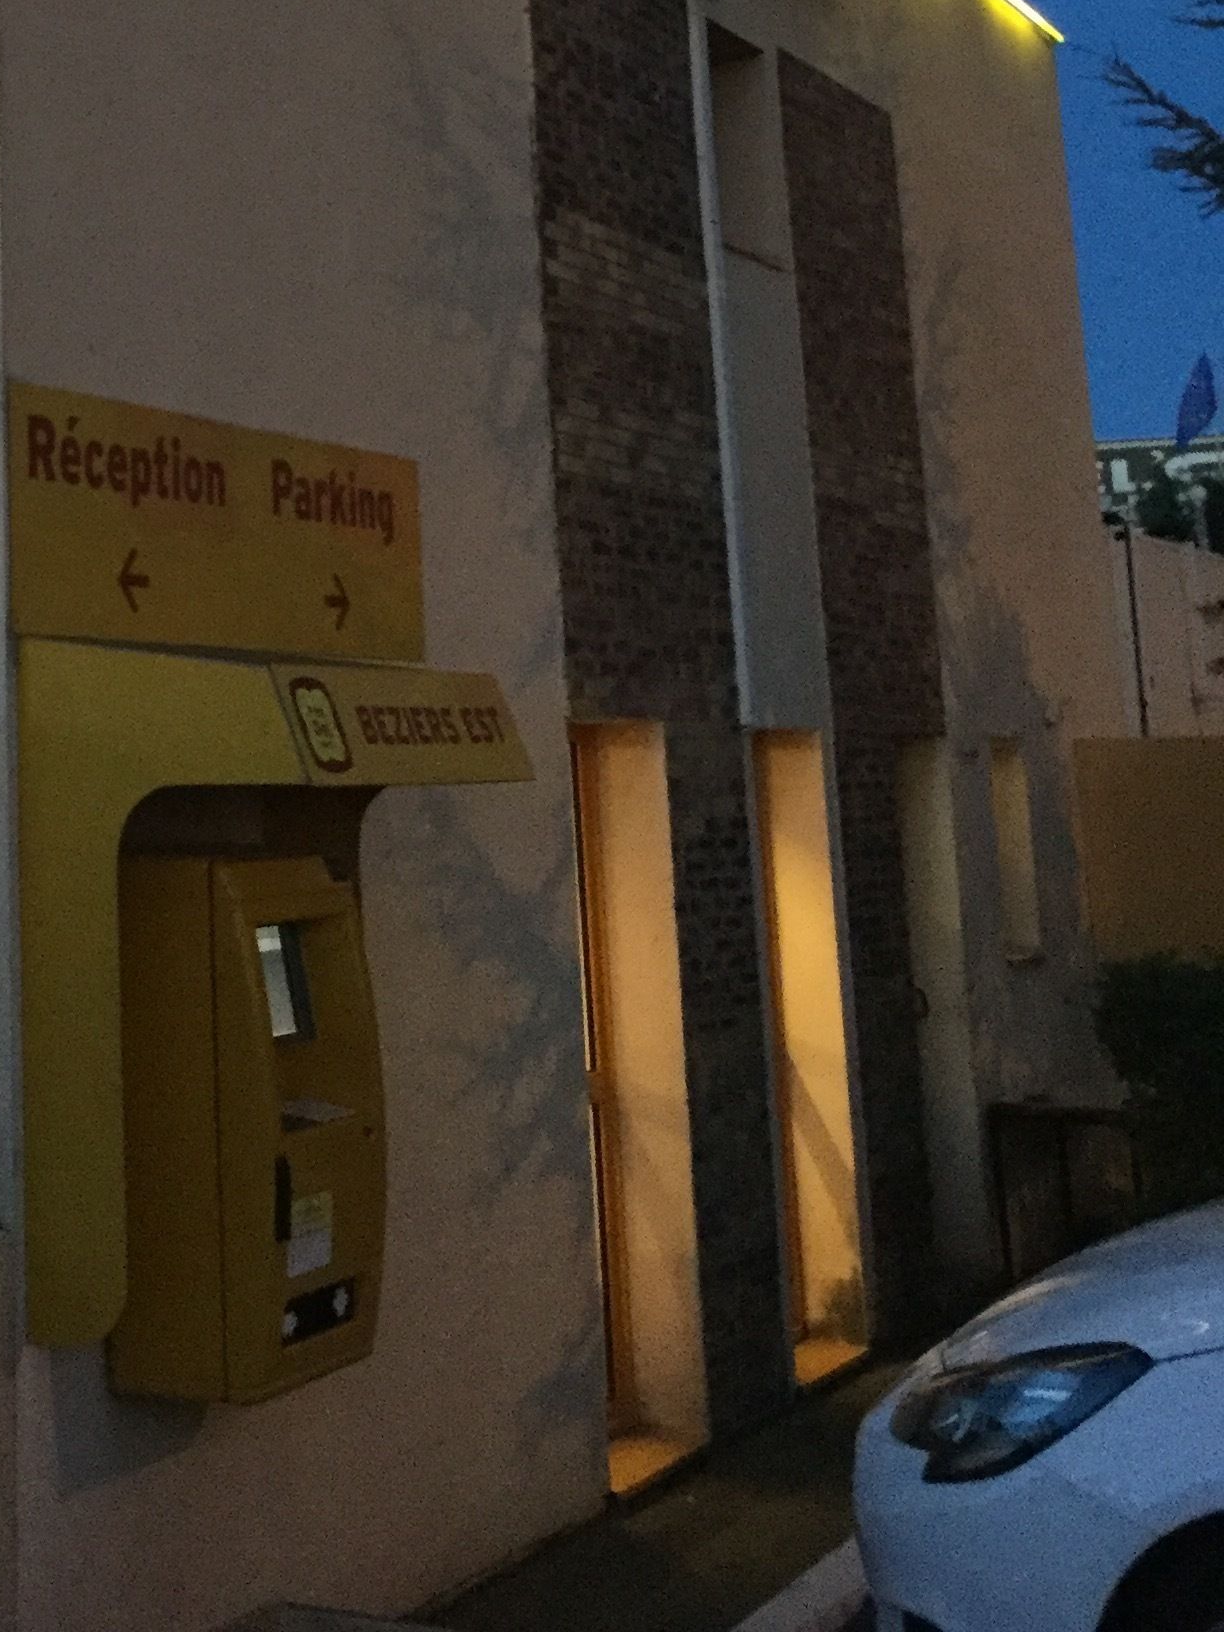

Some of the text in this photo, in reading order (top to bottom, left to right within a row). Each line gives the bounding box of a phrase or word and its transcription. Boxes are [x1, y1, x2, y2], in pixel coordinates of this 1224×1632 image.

[26, 413, 396, 548] Réception Parking
[355, 704, 461, 745] BEZIERS
[458, 704, 505, 744] EST
